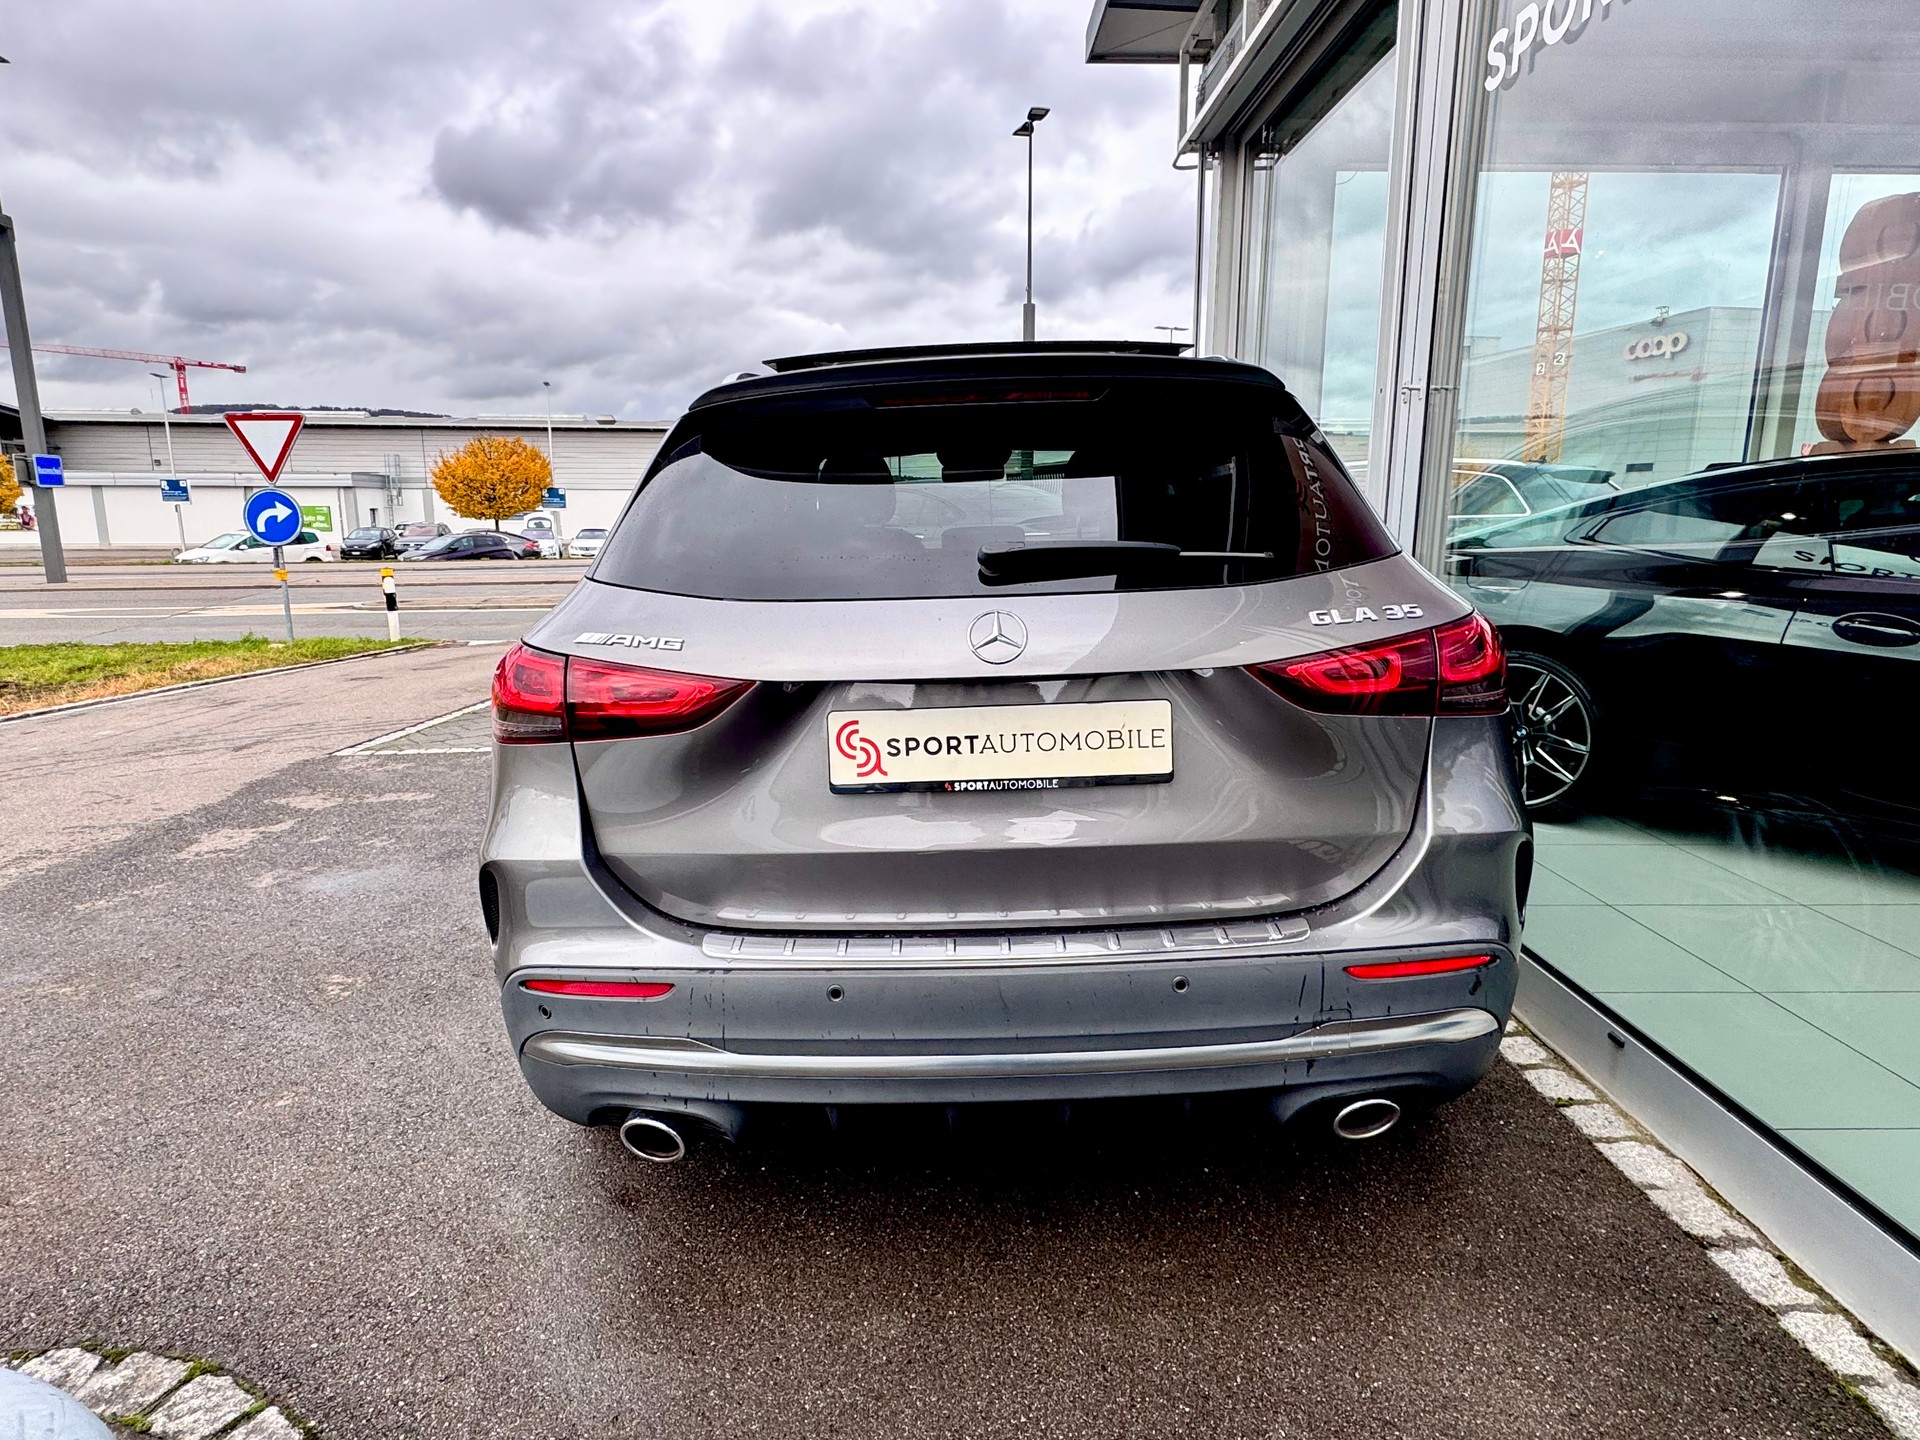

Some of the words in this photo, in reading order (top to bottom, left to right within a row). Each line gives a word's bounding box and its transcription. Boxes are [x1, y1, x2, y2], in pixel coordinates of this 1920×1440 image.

[1623, 332, 1688, 359] coop
[1309, 606, 1379, 626] GLA
[1382, 603, 1424, 620] 35
[606, 633, 685, 651] AMG
[886, 728, 1167, 758] SPORTAUTOMOBILE
[953, 779, 1059, 792] SPORTAUTOMOBILE
